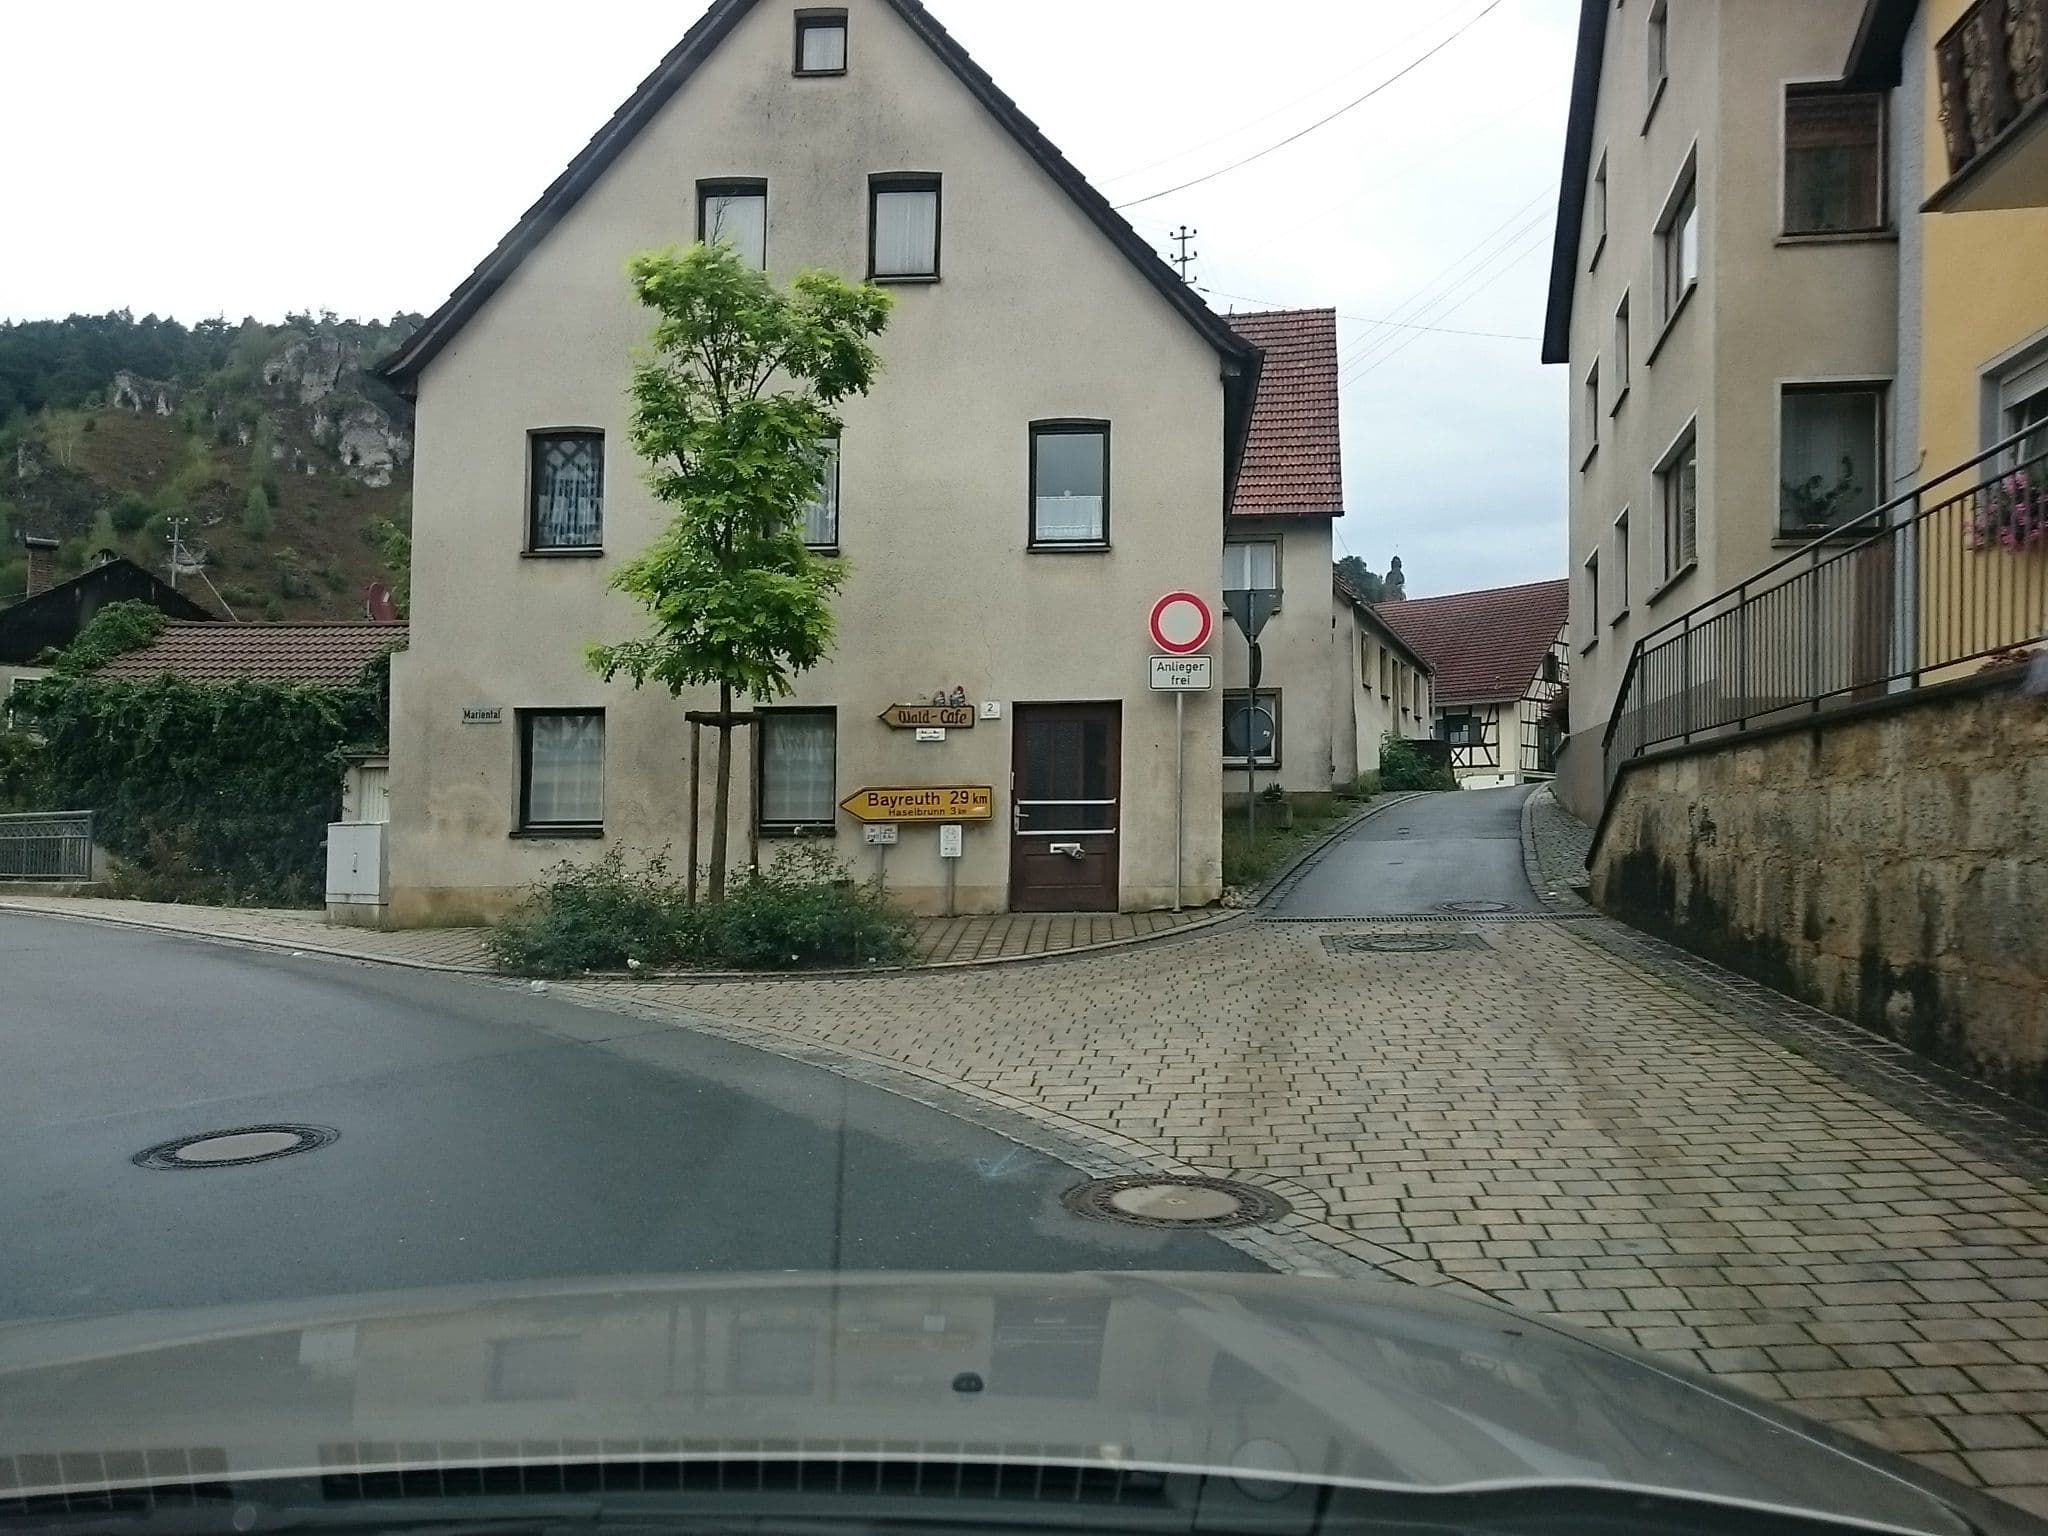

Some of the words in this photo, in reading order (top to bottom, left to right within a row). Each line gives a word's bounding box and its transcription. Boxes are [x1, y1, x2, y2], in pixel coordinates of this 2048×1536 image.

[1156, 661, 1205, 674] Anlieger
[1171, 674, 1191, 685] frei
[987, 703, 994, 712] 2
[463, 709, 501, 720] Mariental
[868, 792, 940, 808] Bayreuth
[950, 790, 969, 805] 29
[972, 792, 988, 805] km
[888, 807, 946, 817] Haselbrunn
[950, 806, 957, 815] 3
